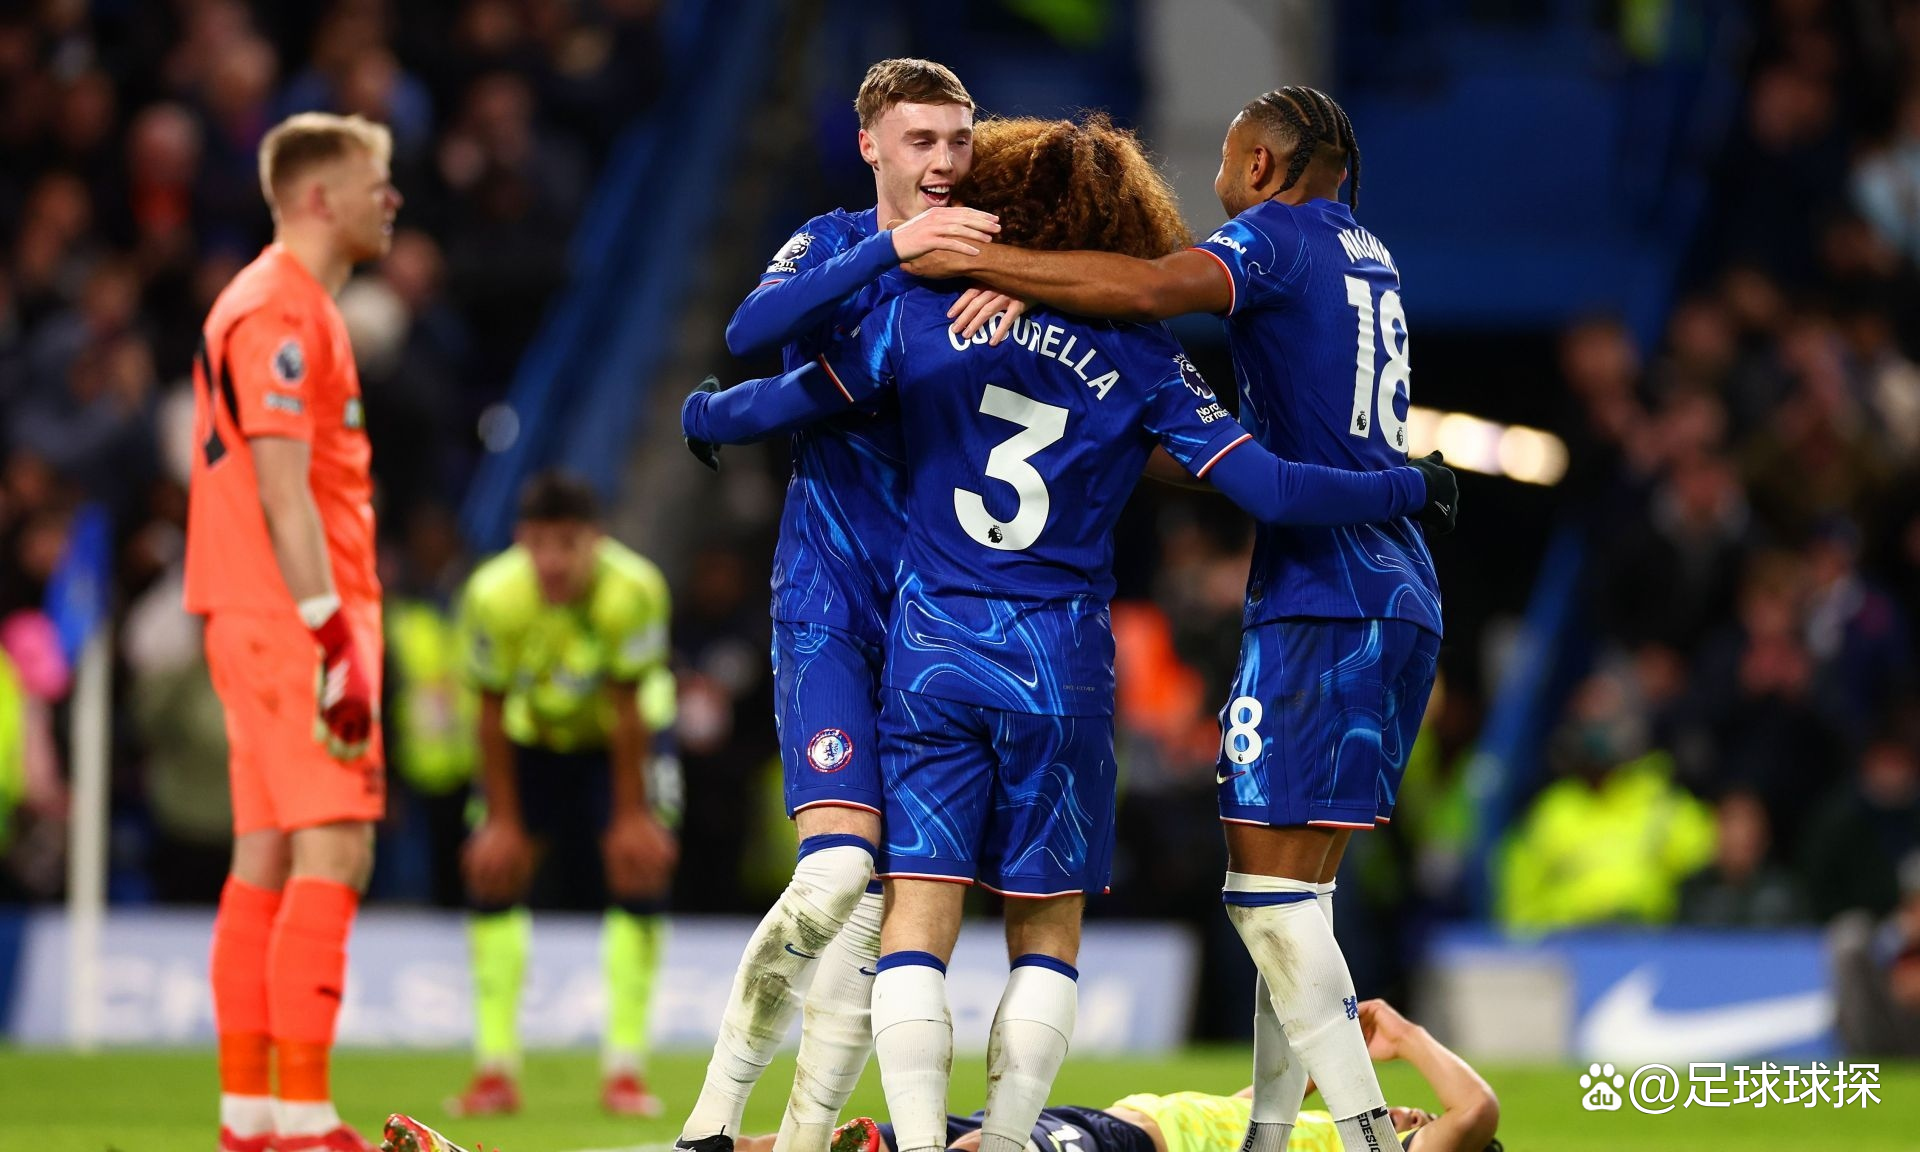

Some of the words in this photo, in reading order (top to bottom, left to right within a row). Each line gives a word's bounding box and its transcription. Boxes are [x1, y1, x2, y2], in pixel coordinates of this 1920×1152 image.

[1344, 274, 1411, 453] 18
[953, 383, 1069, 551] 3
[1225, 695, 1263, 765] 8
